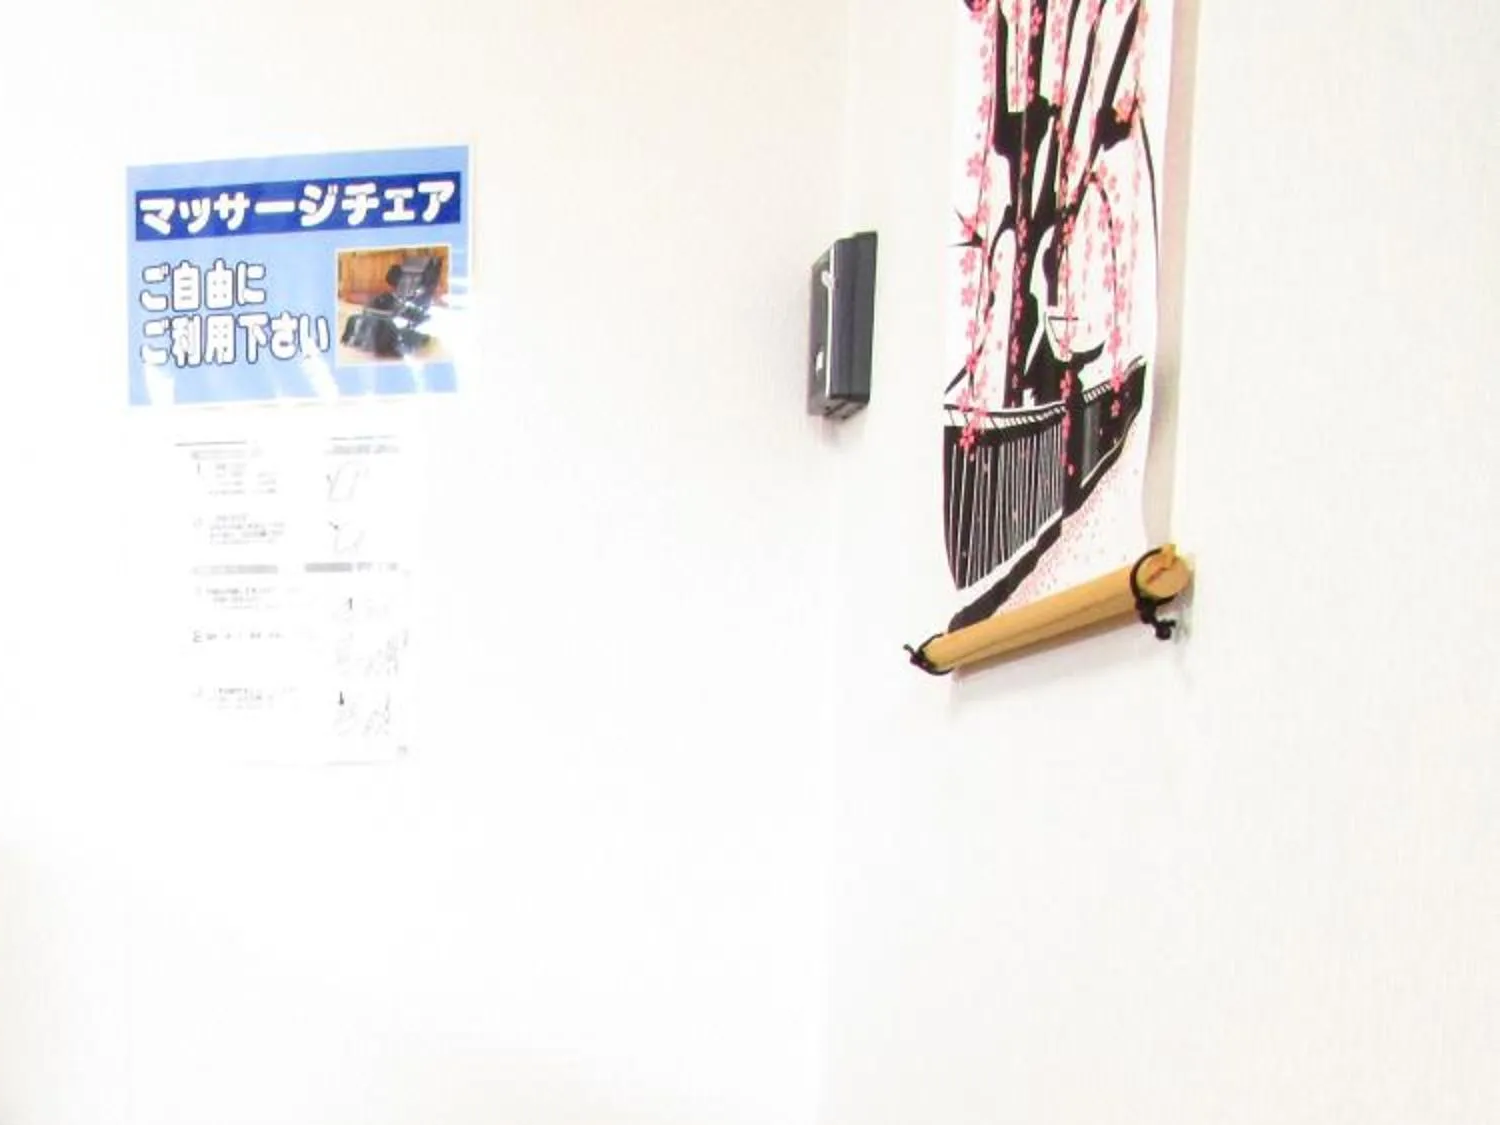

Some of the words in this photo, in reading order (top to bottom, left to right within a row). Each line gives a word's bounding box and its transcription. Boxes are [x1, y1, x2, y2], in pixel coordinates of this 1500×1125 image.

[139, 181, 456, 235] マッサージチェア
[139, 258, 267, 312] ご自由に
[139, 311, 331, 368] ご利用下さい
